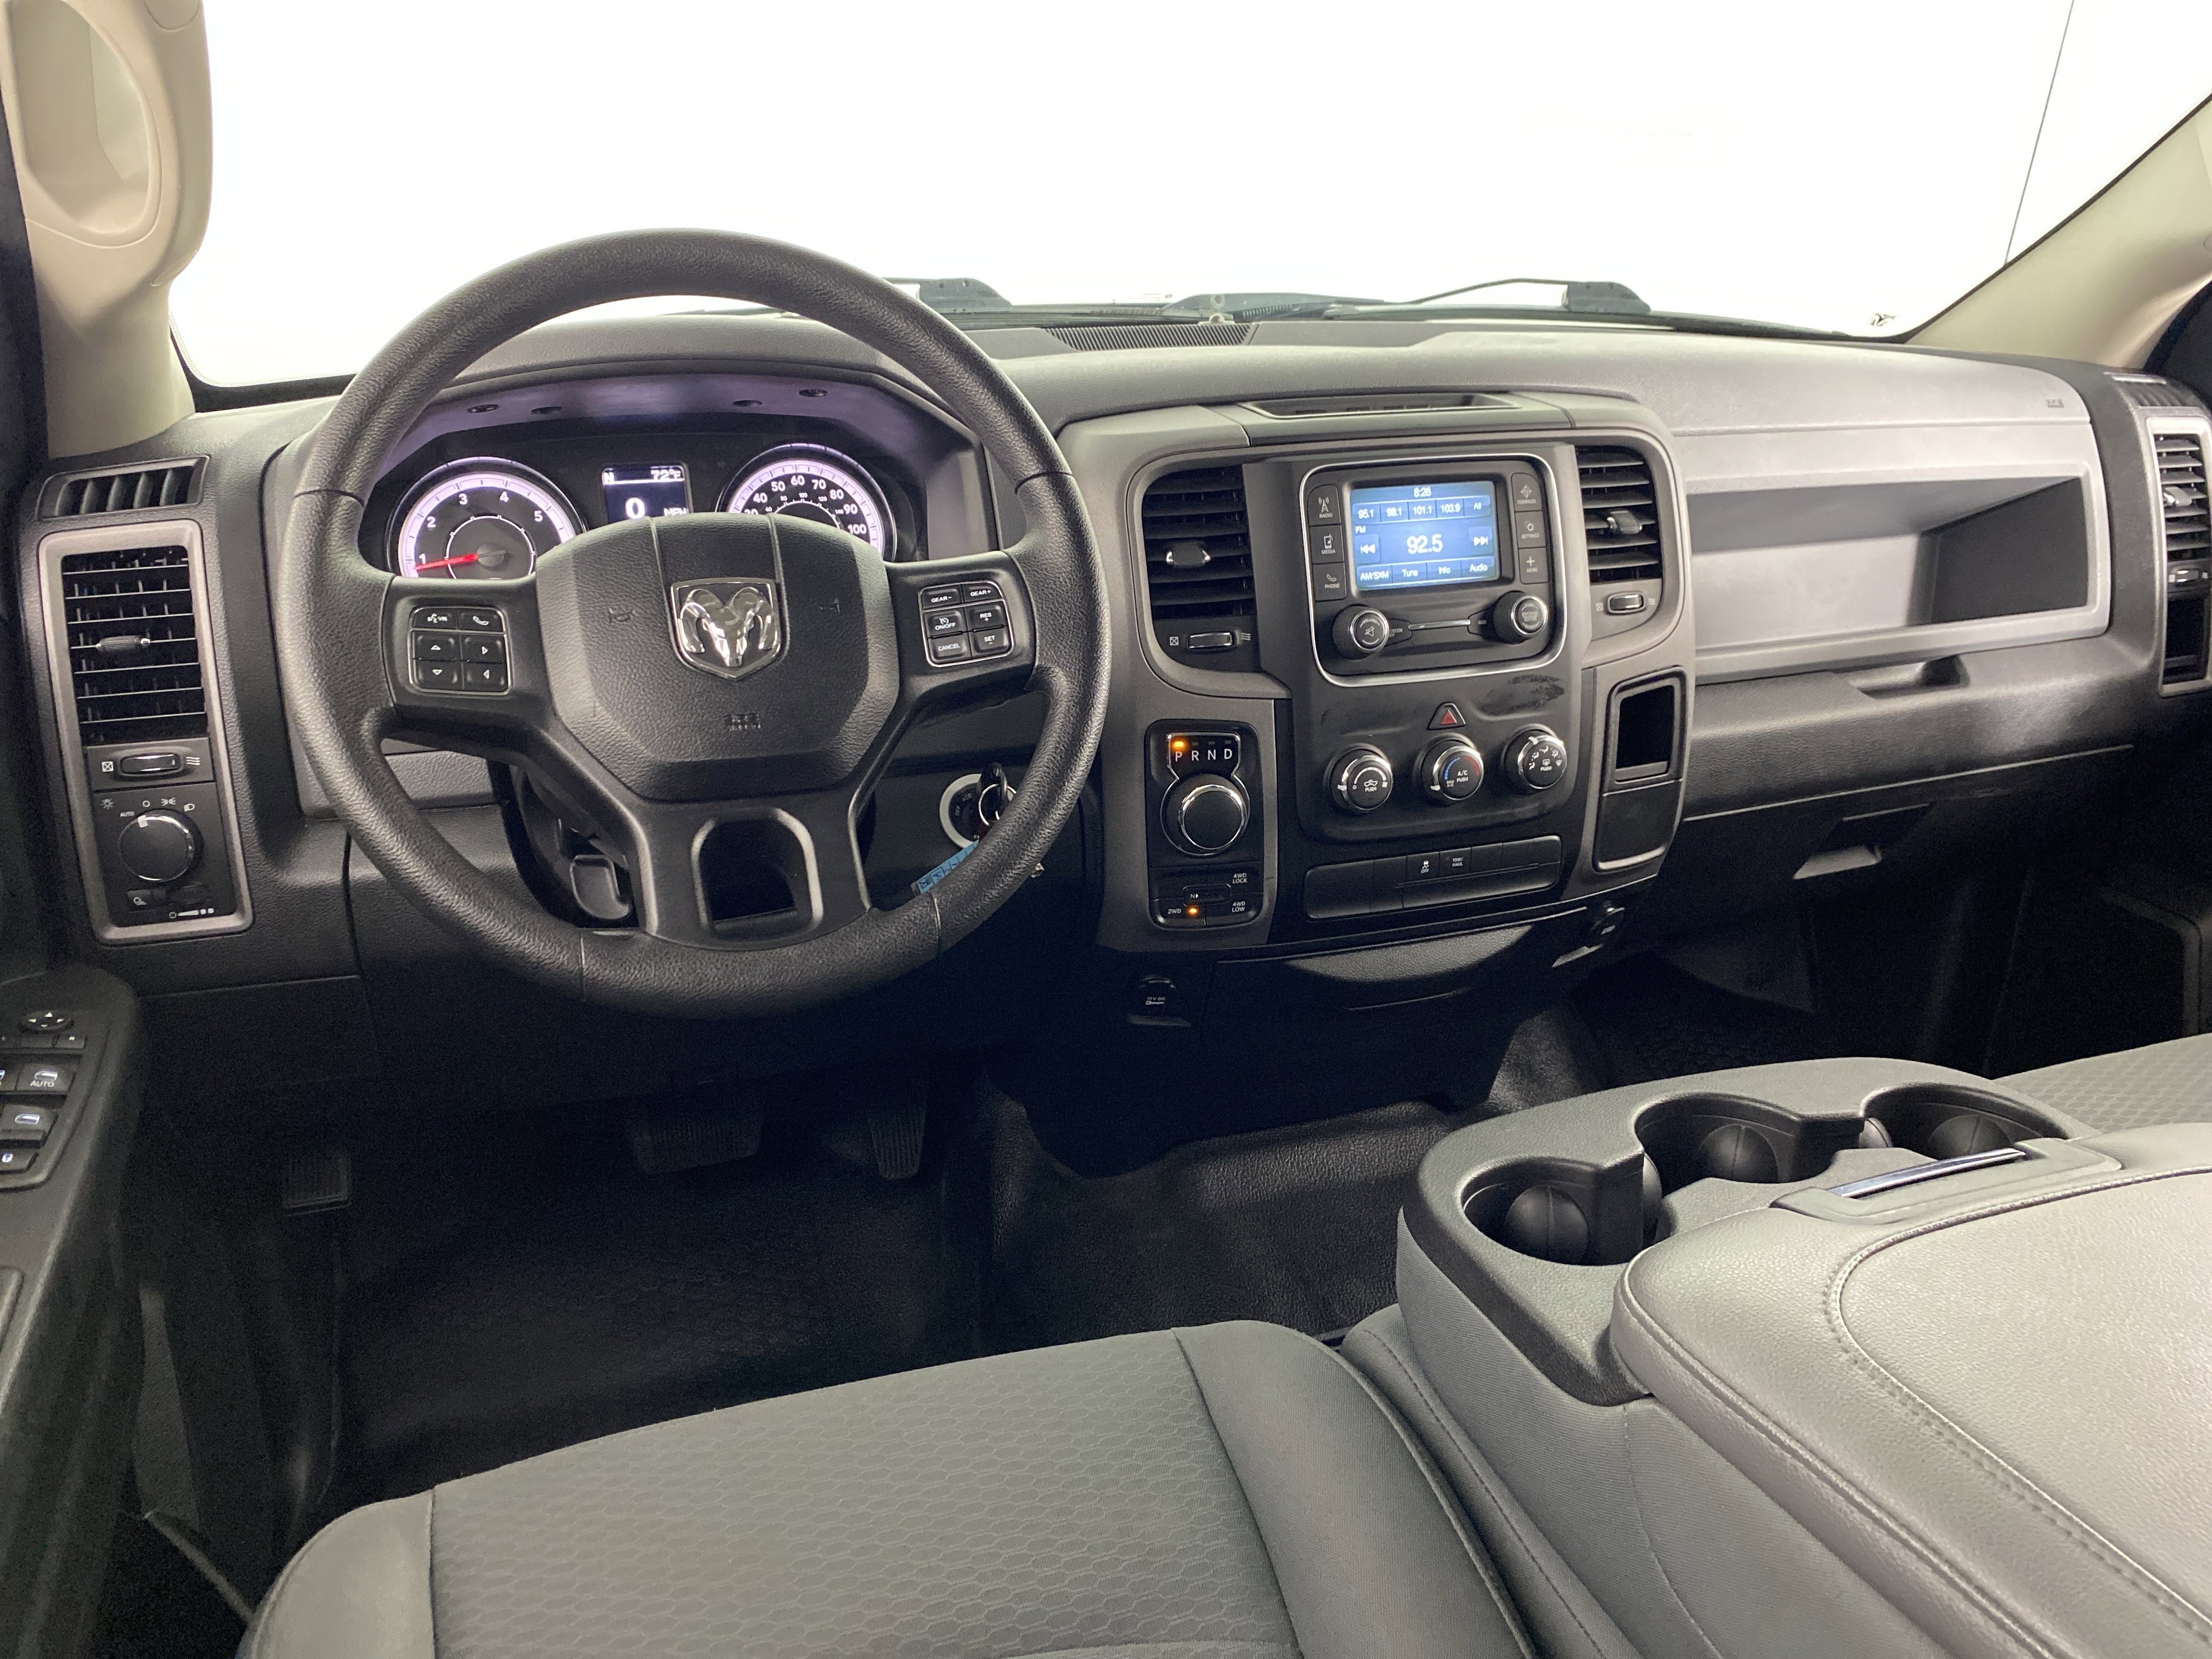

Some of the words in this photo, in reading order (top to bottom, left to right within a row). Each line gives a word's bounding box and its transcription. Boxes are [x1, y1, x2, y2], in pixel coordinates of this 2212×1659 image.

[791, 475, 805, 486] 60
[812, 479, 826, 489] 70
[771, 481, 785, 492] 50
[830, 489, 844, 500] 80
[1414, 487, 1431, 497] 8:26
[459, 494, 467, 505] 3
[500, 492, 509, 503] 4
[753, 493, 768, 503] 40
[625, 497, 645, 518] 0
[843, 504, 857, 514] 90
[534, 511, 543, 522] 5
[427, 517, 436, 528] 2
[848, 524, 867, 534] 100
[1407, 534, 1443, 554] 92.5
[419, 554, 426, 564] 1
[1402, 569, 1418, 578] Tune
[1470, 564, 1488, 573] Audio
[1361, 571, 1389, 580] AM/SXM
[935, 622, 956, 630] ON/OFF
[938, 643, 961, 651] CANCEL
[1175, 752, 1182, 761] P
[1192, 751, 1199, 761] R
[1207, 749, 1216, 760] N
[1224, 748, 1232, 759] D
